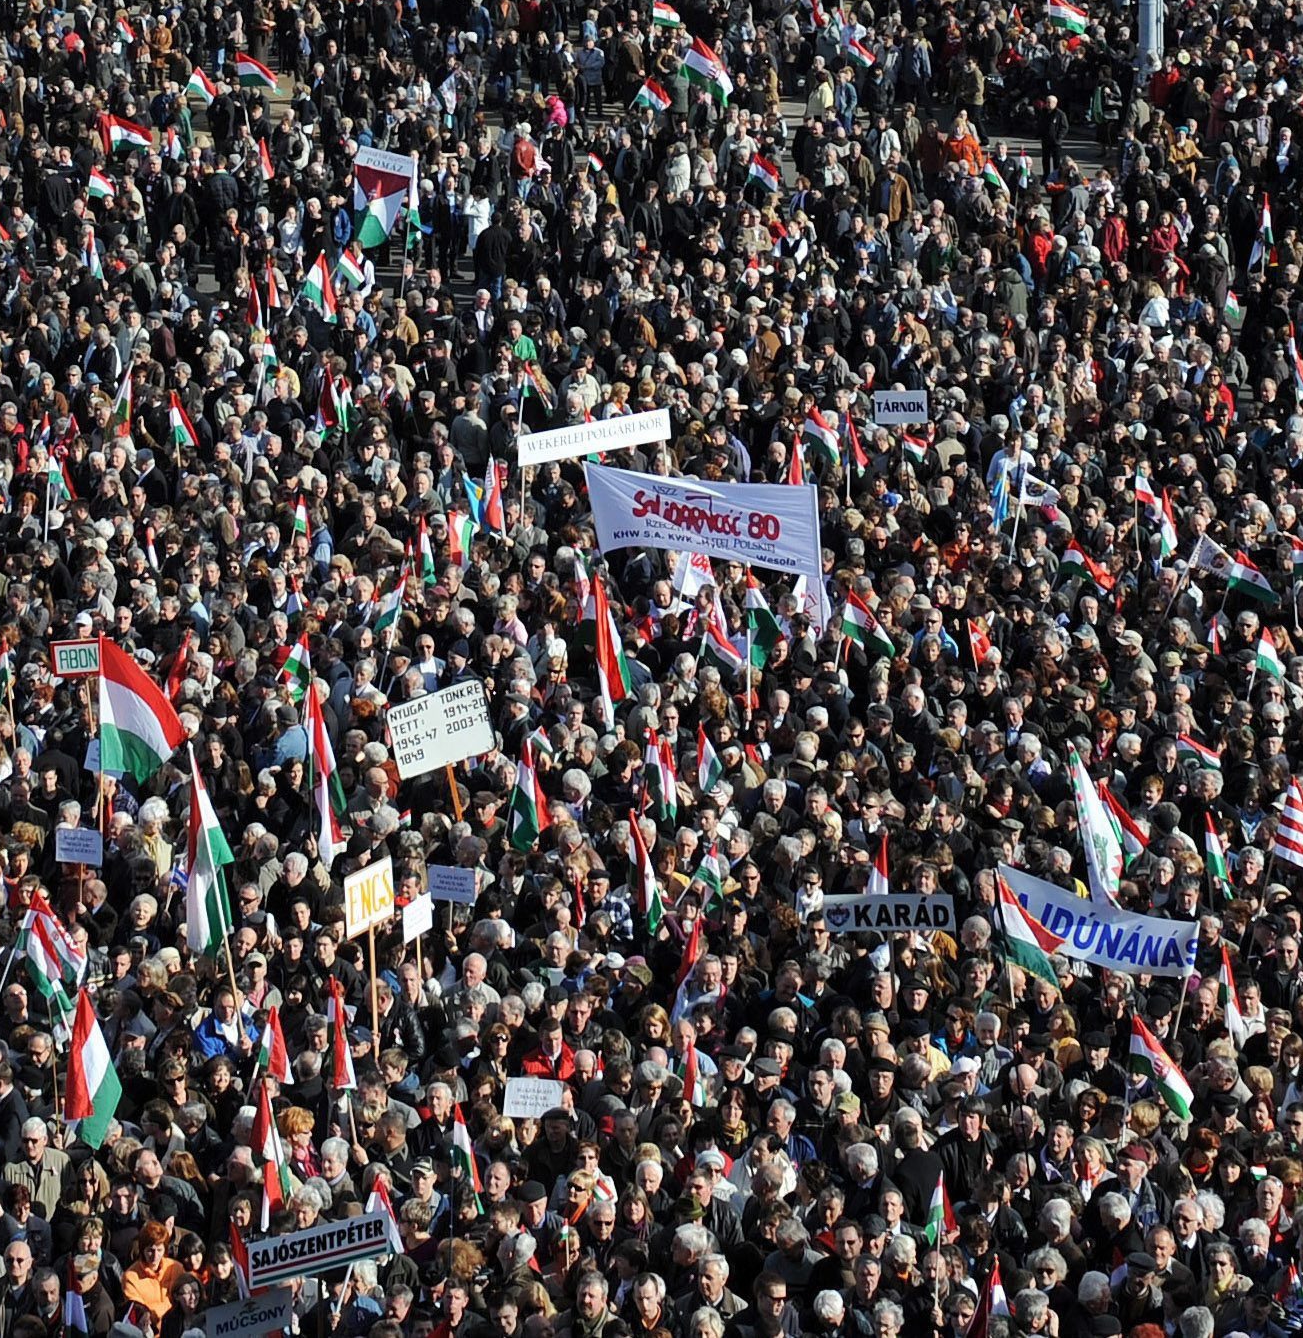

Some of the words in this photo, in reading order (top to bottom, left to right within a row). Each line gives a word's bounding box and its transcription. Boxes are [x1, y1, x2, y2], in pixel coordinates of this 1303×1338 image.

[876, 399, 924, 413] TÁRNOK
[613, 530, 640, 541] KHW
[668, 533, 693, 544] KWK
[748, 512, 781, 541] 80
[733, 538, 776, 554] POLSKIEJ
[390, 700, 430, 723] NYUGAT
[444, 697, 487, 719] 1914-20
[396, 728, 438, 751] 1945-47
[853, 896, 950, 928] KARÁD
[251, 1218, 384, 1269] SAJÓSZENTPÉTER
